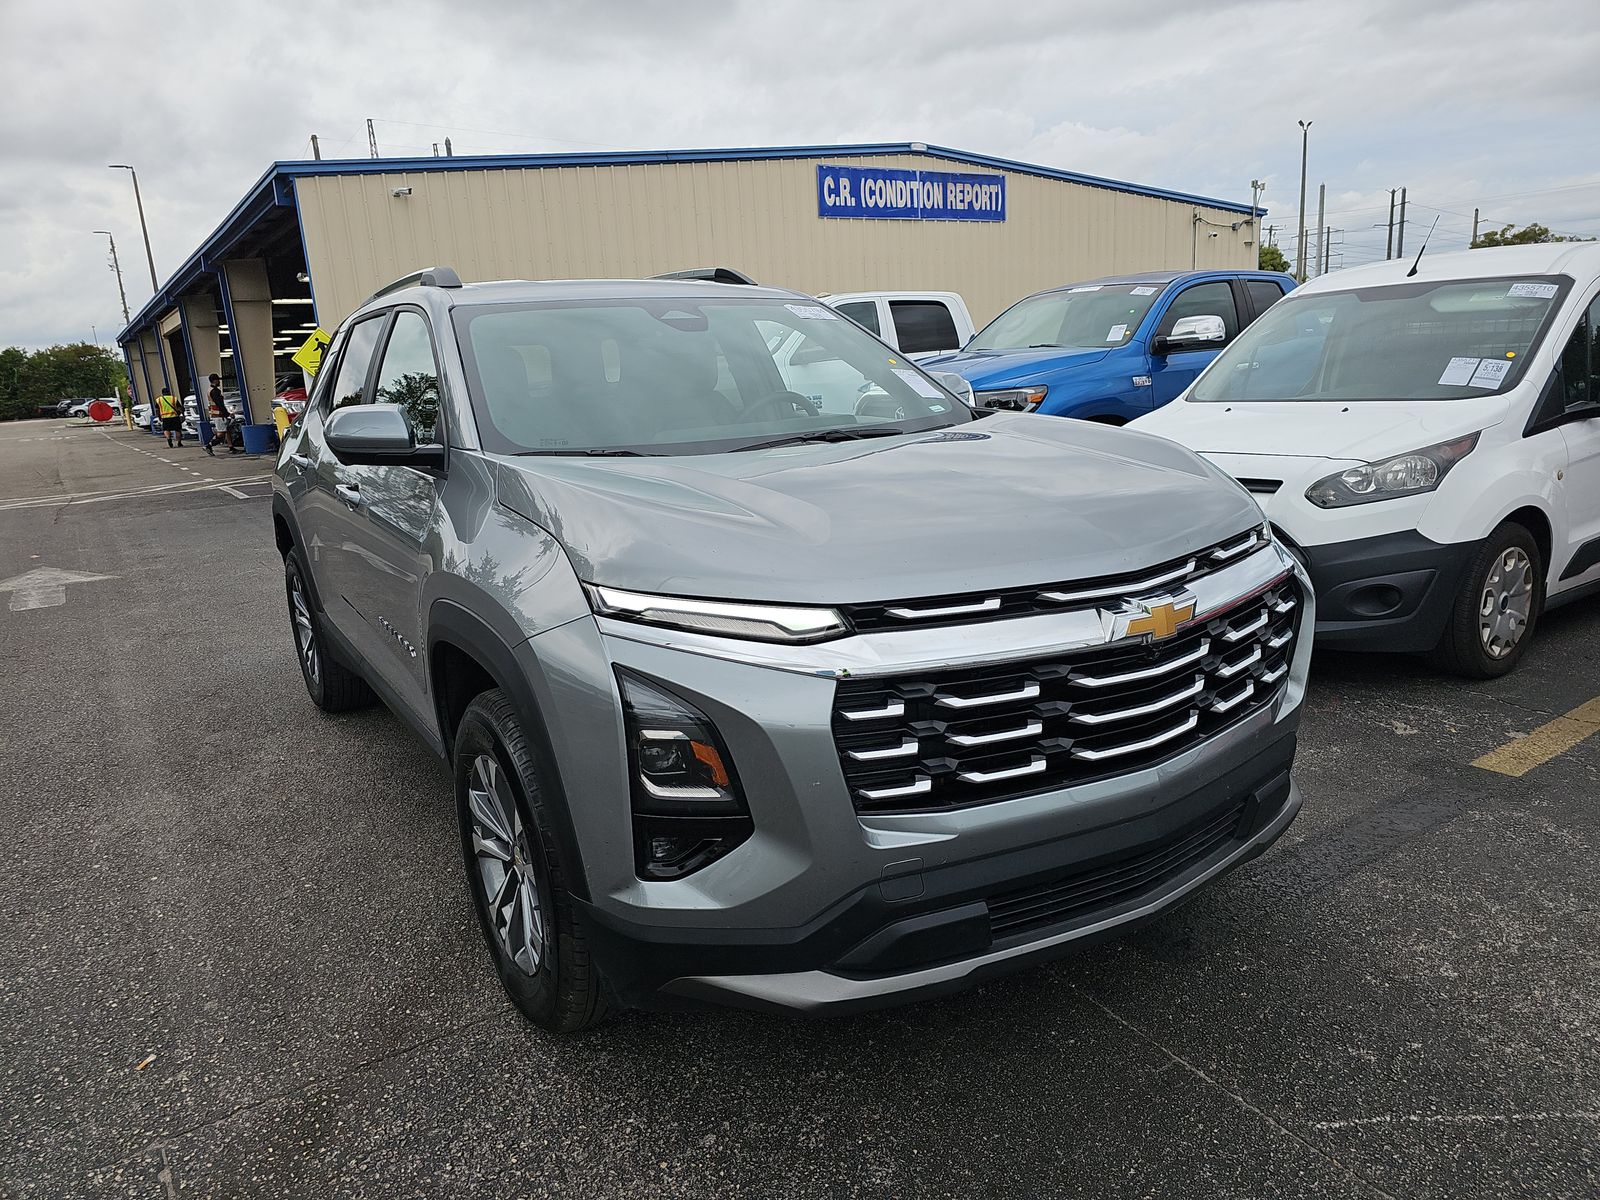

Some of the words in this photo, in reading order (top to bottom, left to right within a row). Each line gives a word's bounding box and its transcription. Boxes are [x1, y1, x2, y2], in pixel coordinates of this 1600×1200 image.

[823, 175, 856, 207] C.R.
[860, 177, 943, 210] (CONDITION
[947, 181, 1002, 212] REPORT)
[1512, 284, 1554, 292] 4355710
